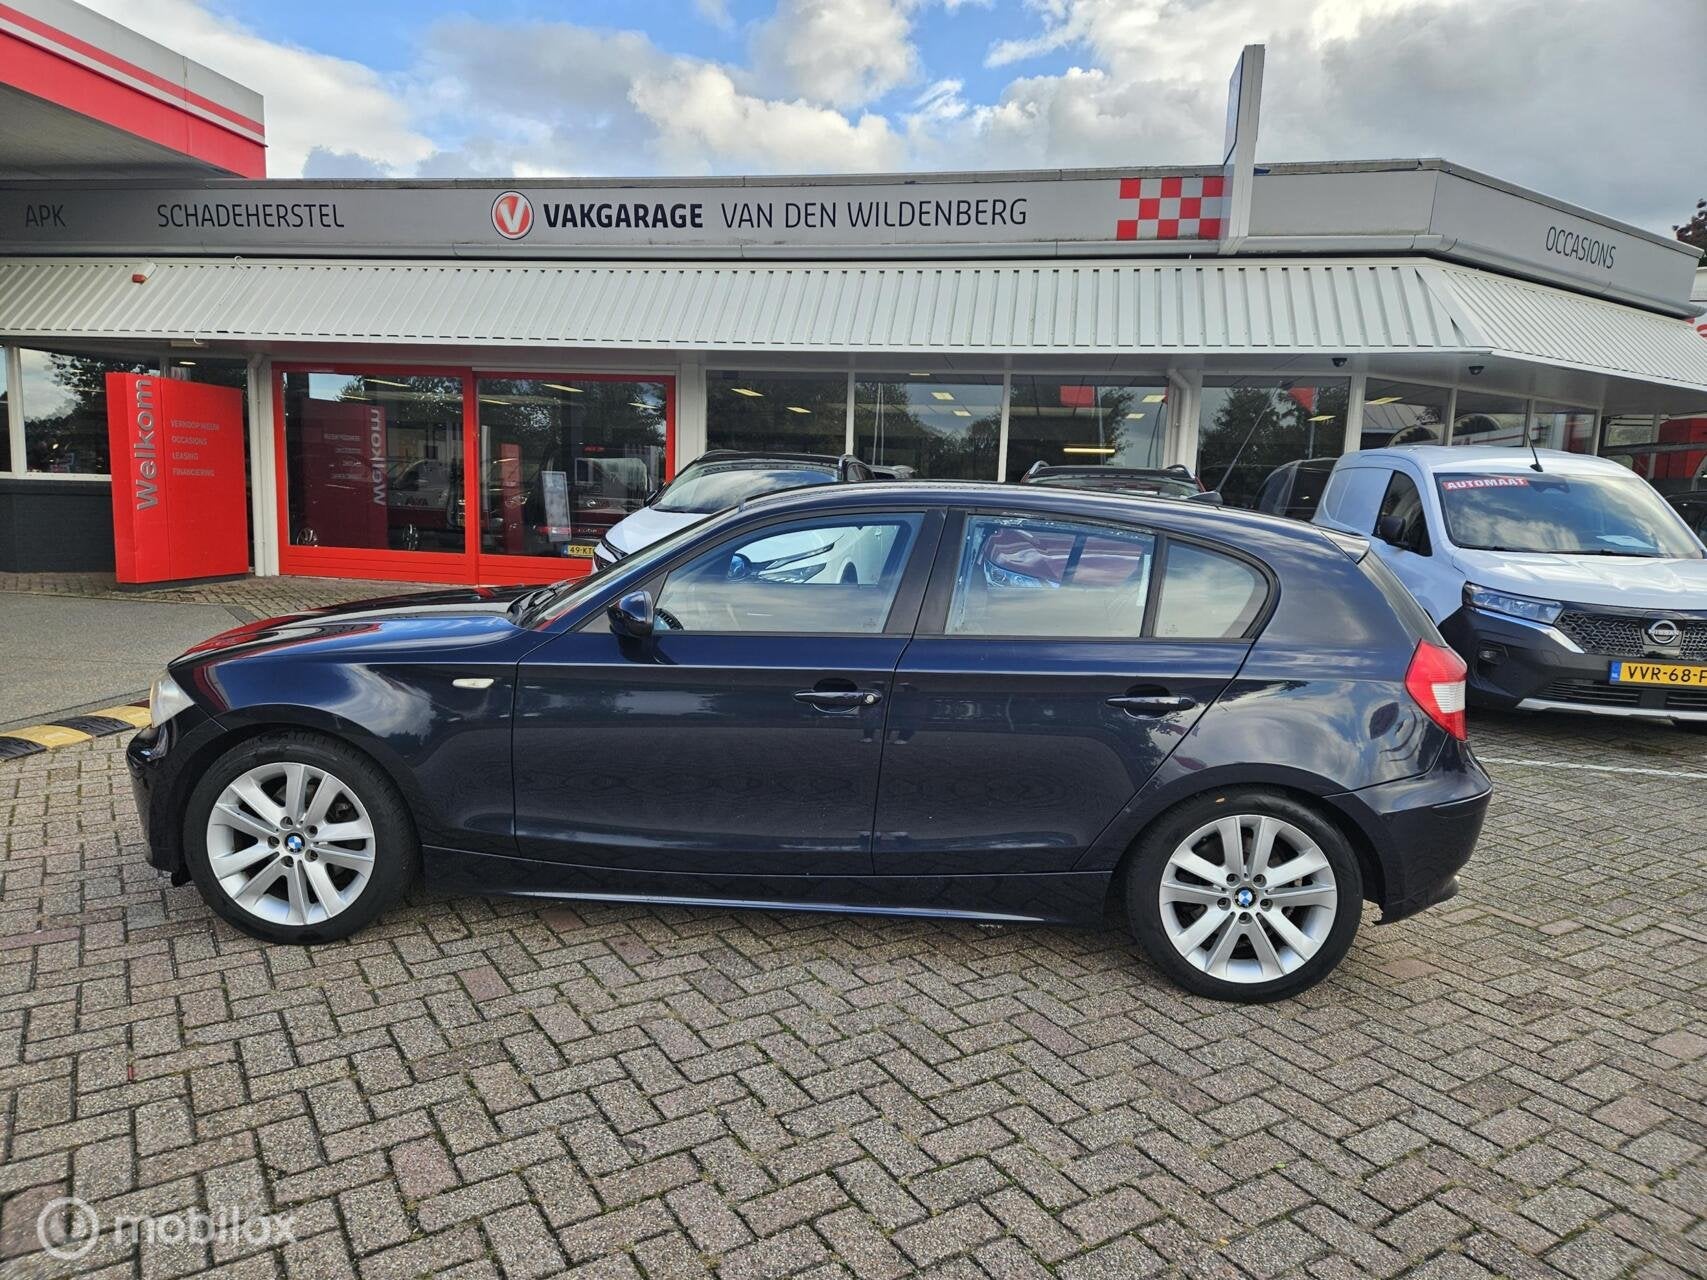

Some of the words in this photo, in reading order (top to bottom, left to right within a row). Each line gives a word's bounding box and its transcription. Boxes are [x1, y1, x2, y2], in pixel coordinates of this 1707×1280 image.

[25, 204, 67, 227] APK
[157, 204, 345, 228] SCHADEHERSTEL
[543, 203, 704, 229] VAKGARAGE
[720, 203, 773, 228] VAN
[785, 202, 837, 228] DEN
[847, 199, 1028, 227] WILDENBERG
[1545, 226, 1617, 269] OCCASIONS
[133, 379, 159, 511] Welkom
[171, 435, 208, 446] OCCASIONS
[172, 451, 199, 461] LEASING
[1447, 478, 1525, 489] AUTOMAAT
[569, 546, 595, 555] 49-KT
[1627, 665, 1707, 683] VVR-68-F
